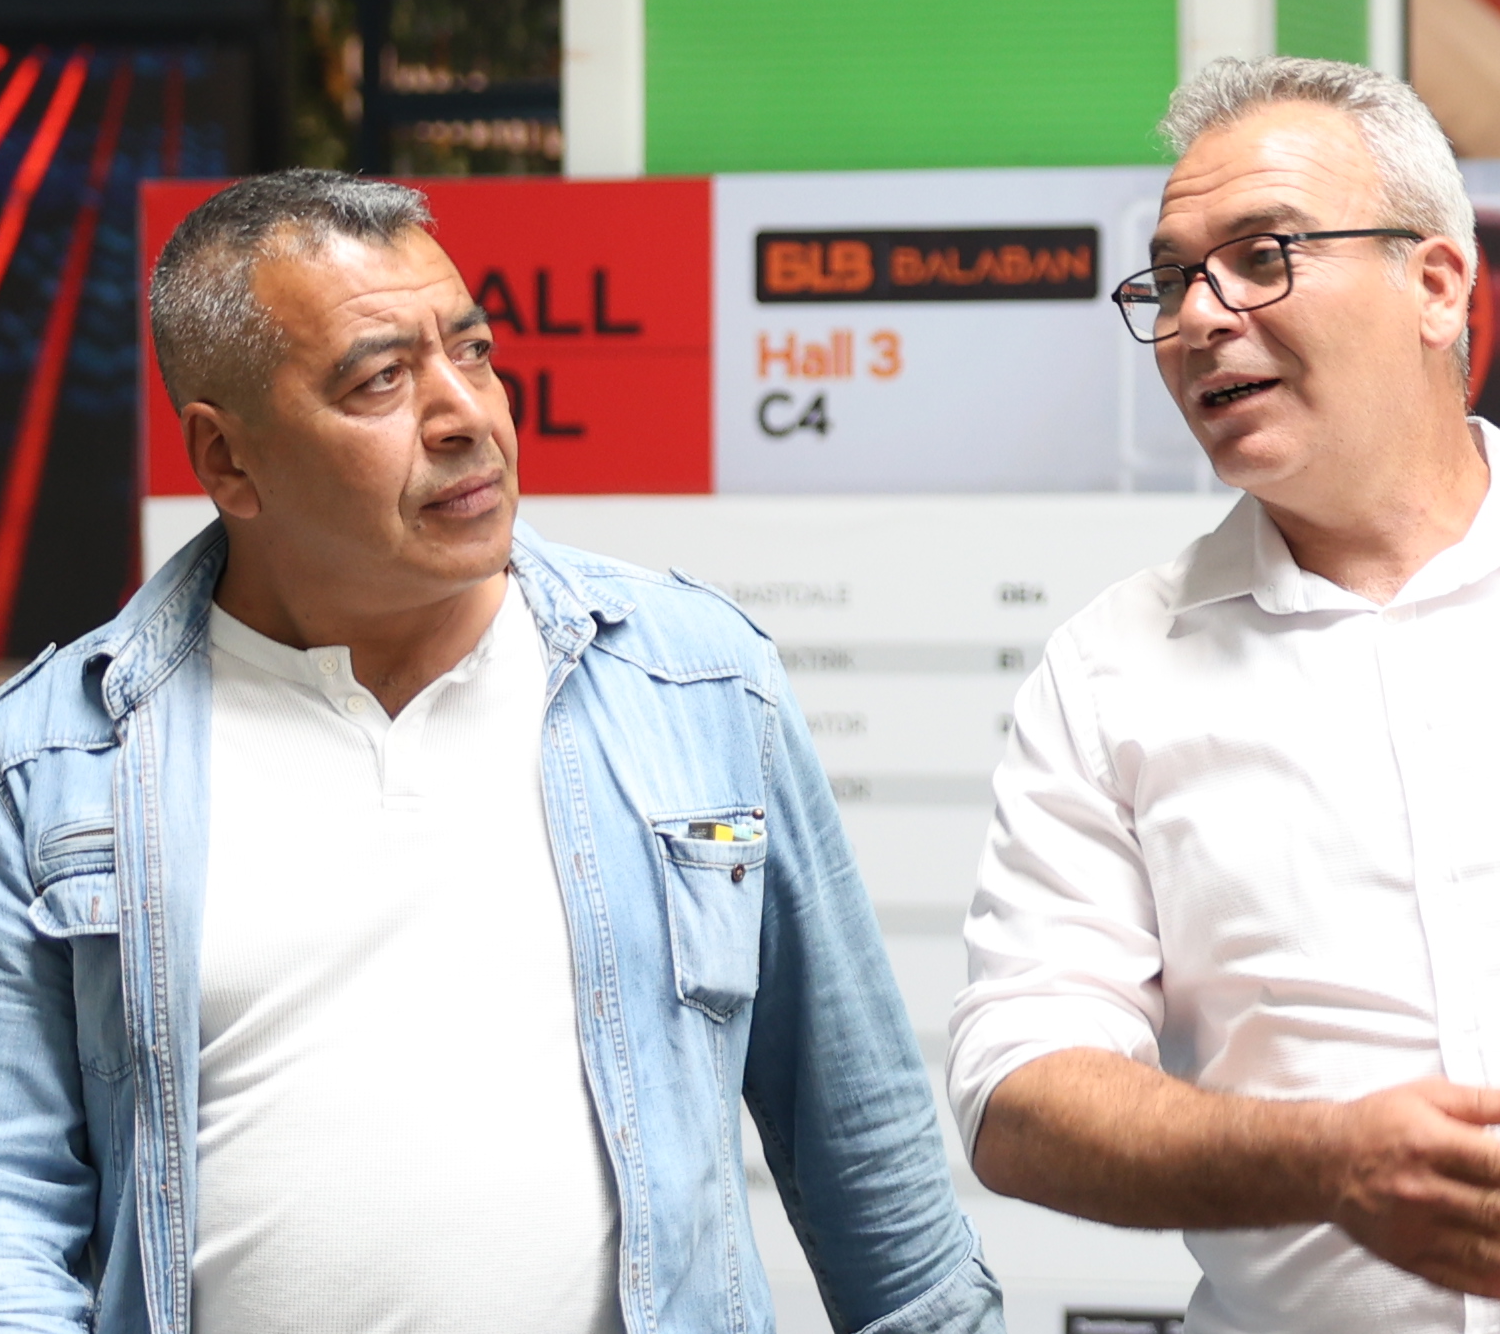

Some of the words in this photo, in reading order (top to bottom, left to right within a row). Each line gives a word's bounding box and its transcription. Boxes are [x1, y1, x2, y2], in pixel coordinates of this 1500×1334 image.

[763, 240, 875, 295] BLB
[889, 244, 1092, 287] BALABAN
[476, 267, 642, 336] ALL
[757, 327, 855, 382] Hall
[867, 328, 904, 381] 3
[757, 389, 831, 441] C4
